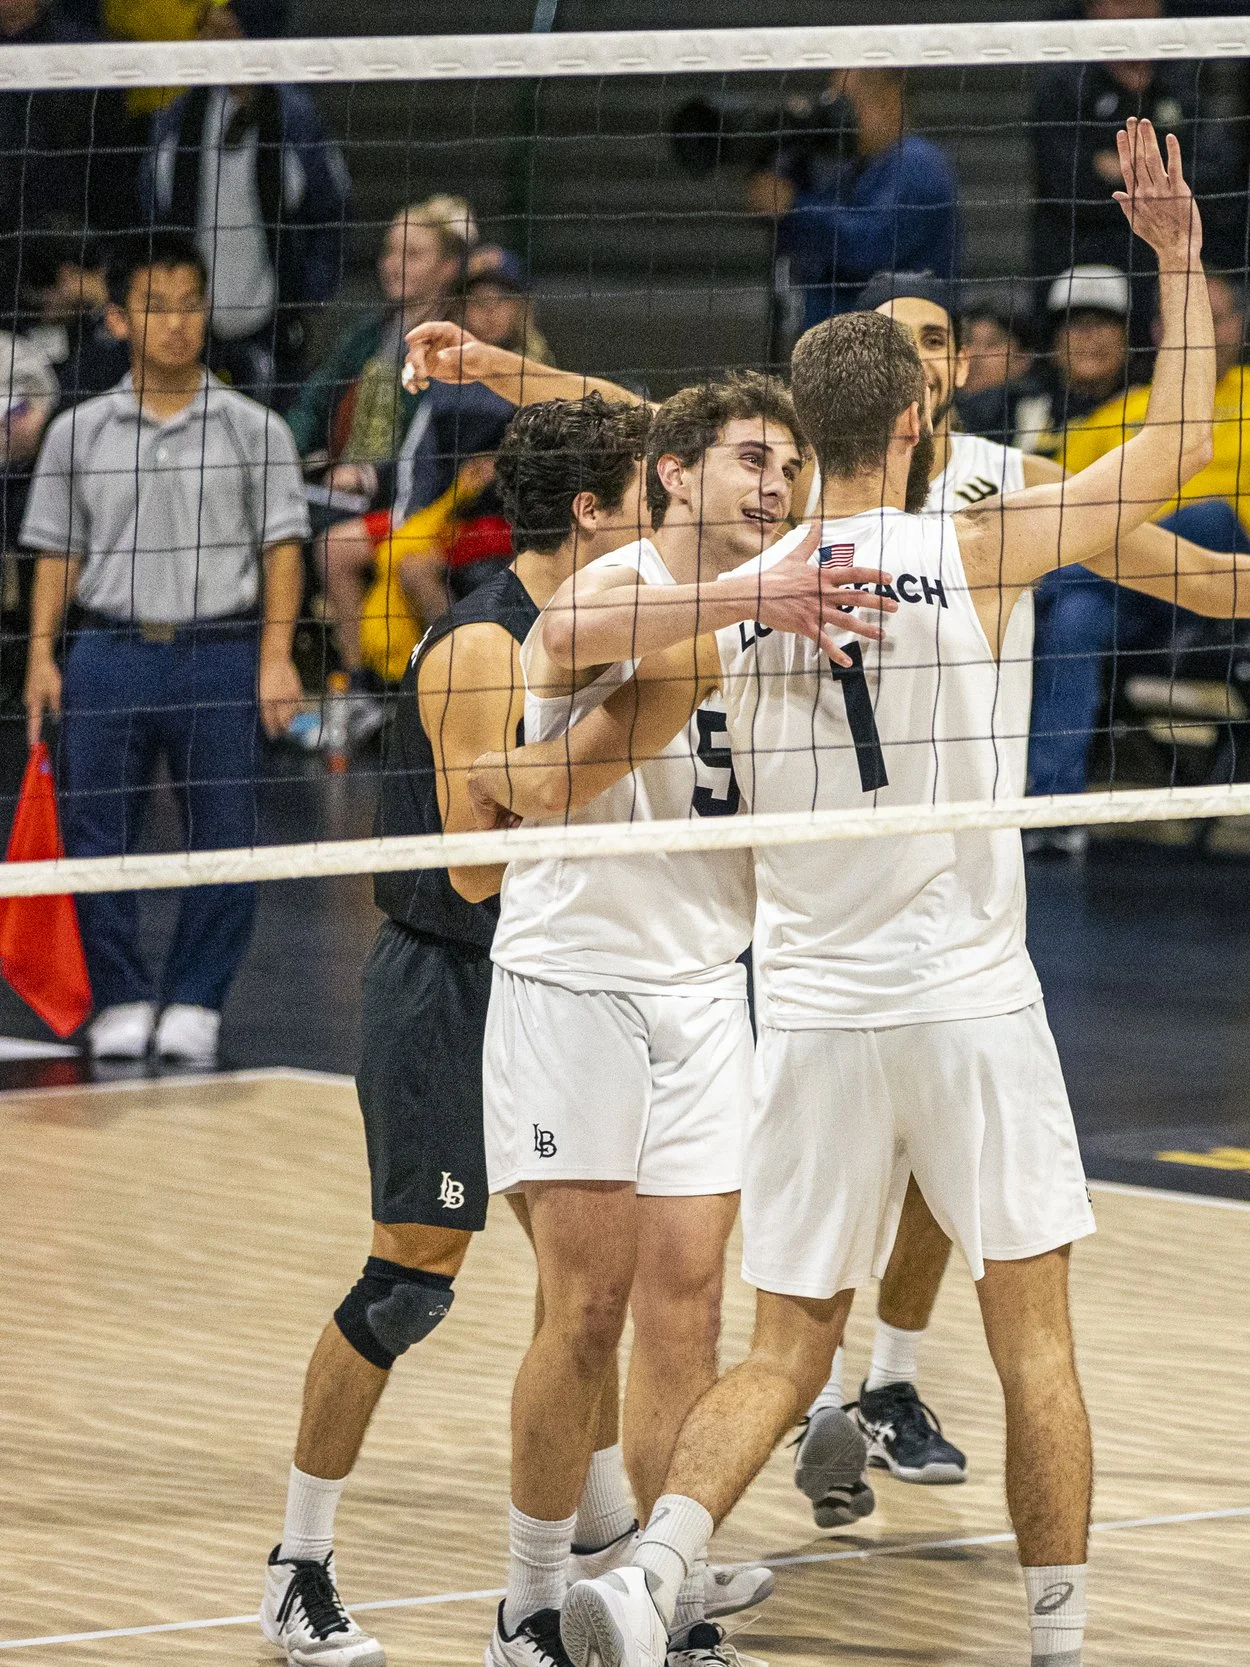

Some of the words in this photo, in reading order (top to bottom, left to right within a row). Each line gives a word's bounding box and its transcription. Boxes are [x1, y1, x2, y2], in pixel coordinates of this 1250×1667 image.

[829, 640, 889, 793] 1
[691, 708, 741, 817] 5
[532, 1123, 558, 1159] LB
[437, 1171, 465, 1209] LB
